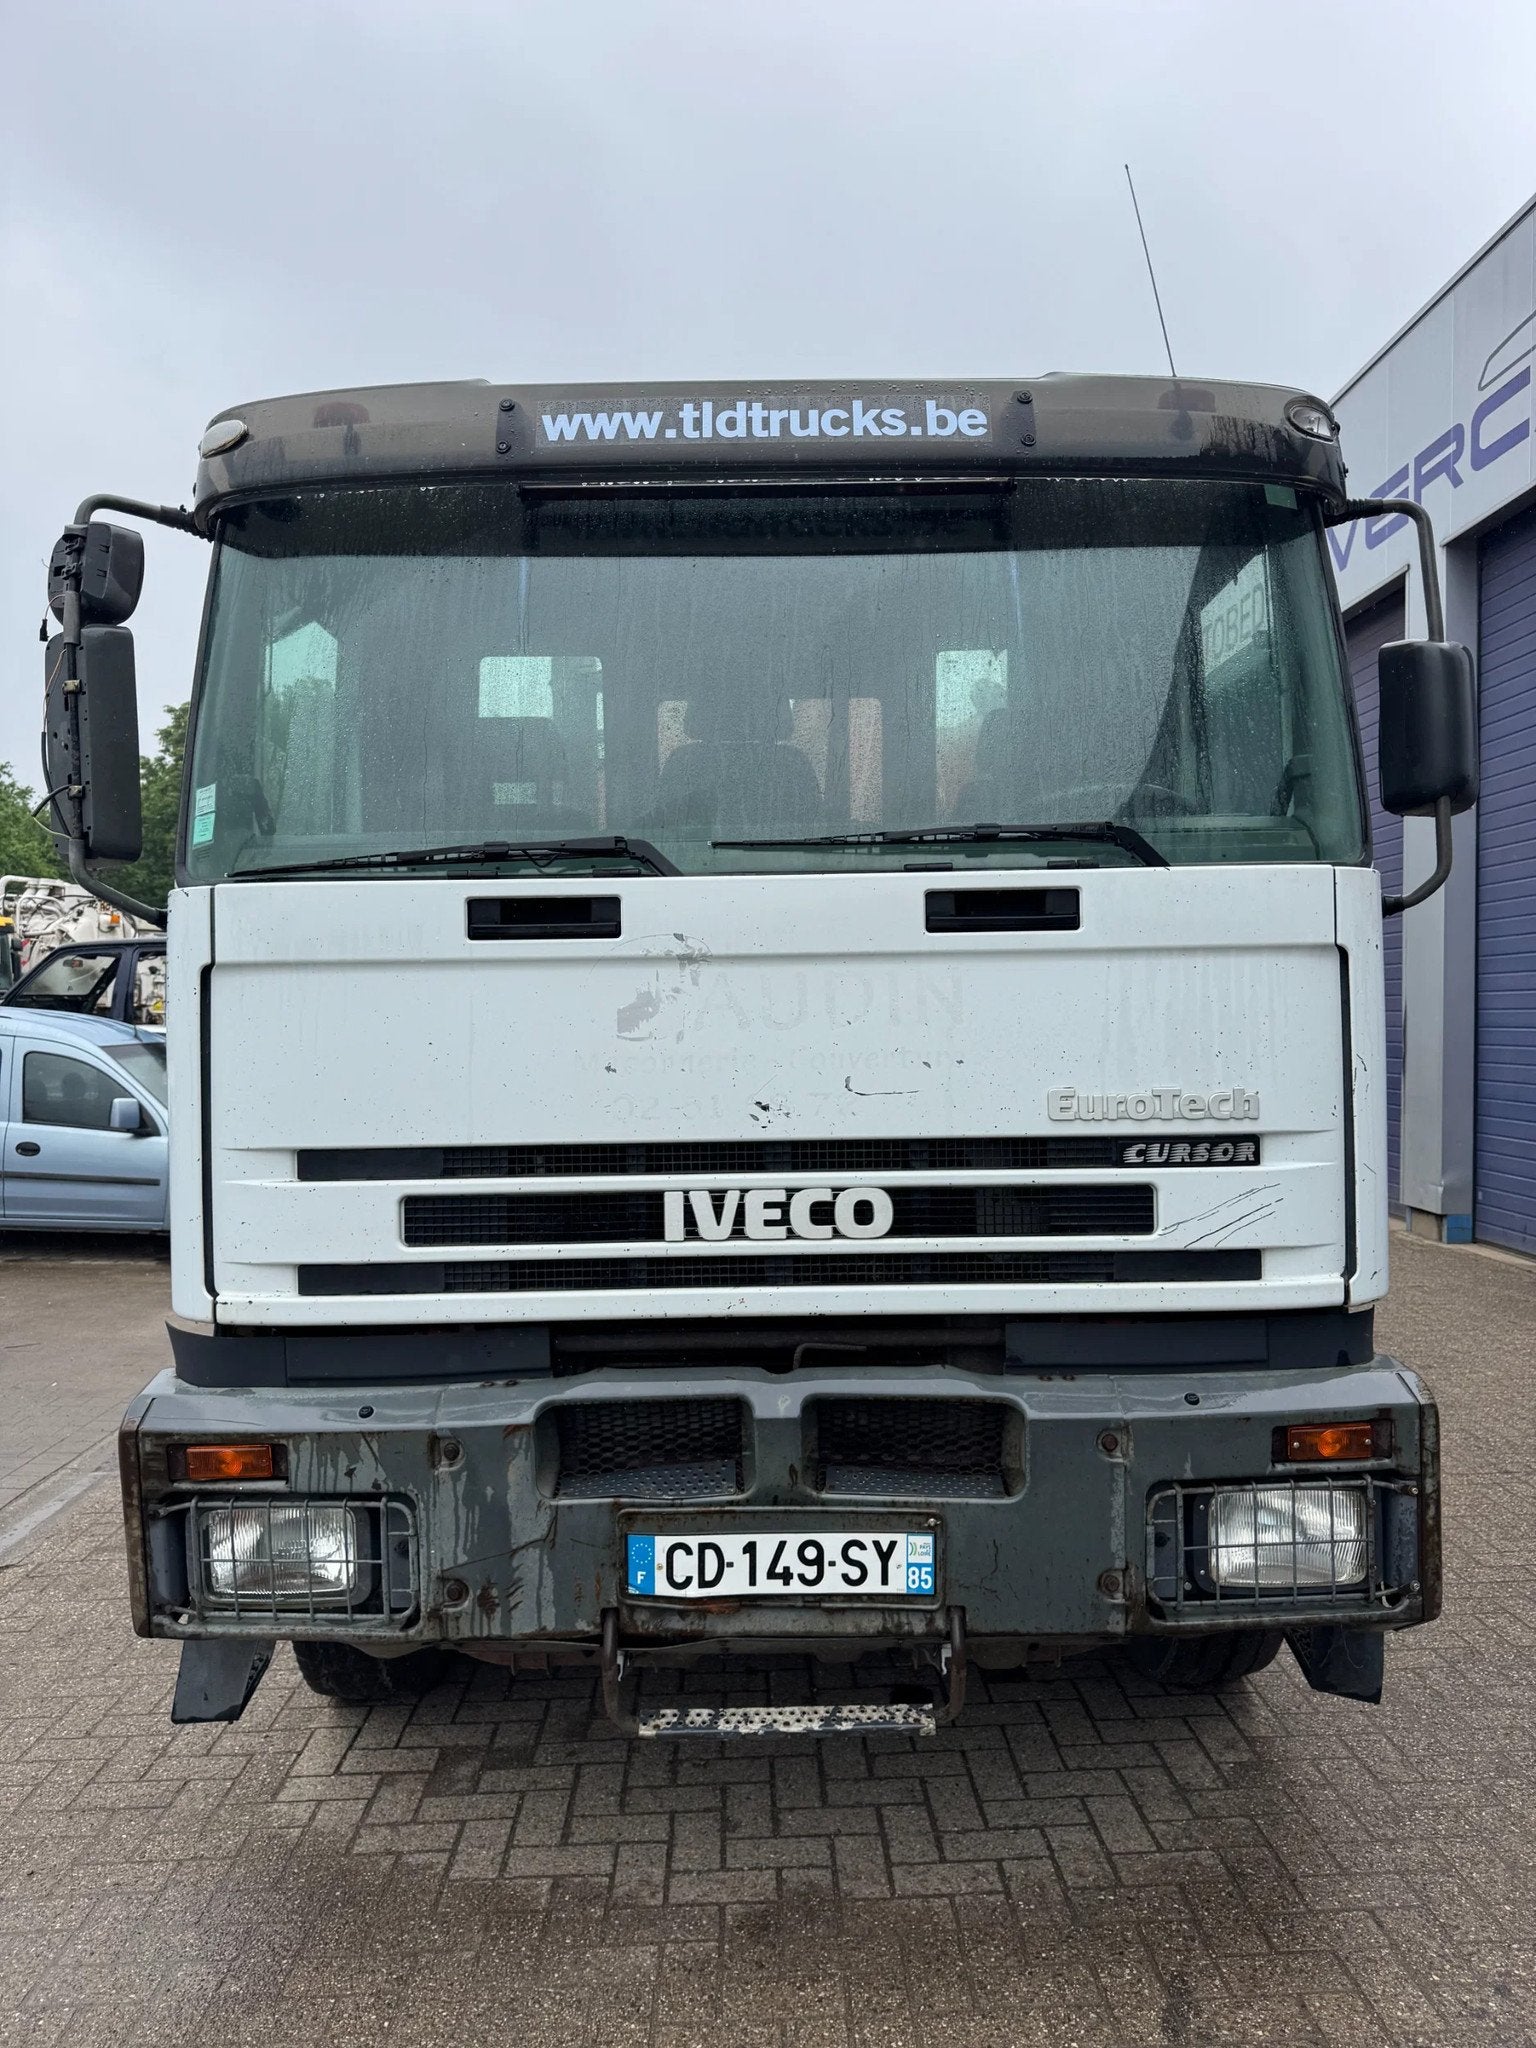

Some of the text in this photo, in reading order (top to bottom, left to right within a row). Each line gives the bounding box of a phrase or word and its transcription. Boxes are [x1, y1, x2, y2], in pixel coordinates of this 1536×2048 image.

[541, 399, 988, 442] www.tldtrucks.be
[1047, 1086, 1260, 1121] EuroTech
[1122, 1142, 1256, 1163] CURSOR
[664, 1187, 894, 1242] IVECO
[637, 1571, 646, 1585] F
[665, 1538, 898, 1591] CD-149-SY
[908, 1566, 932, 1589] 85
